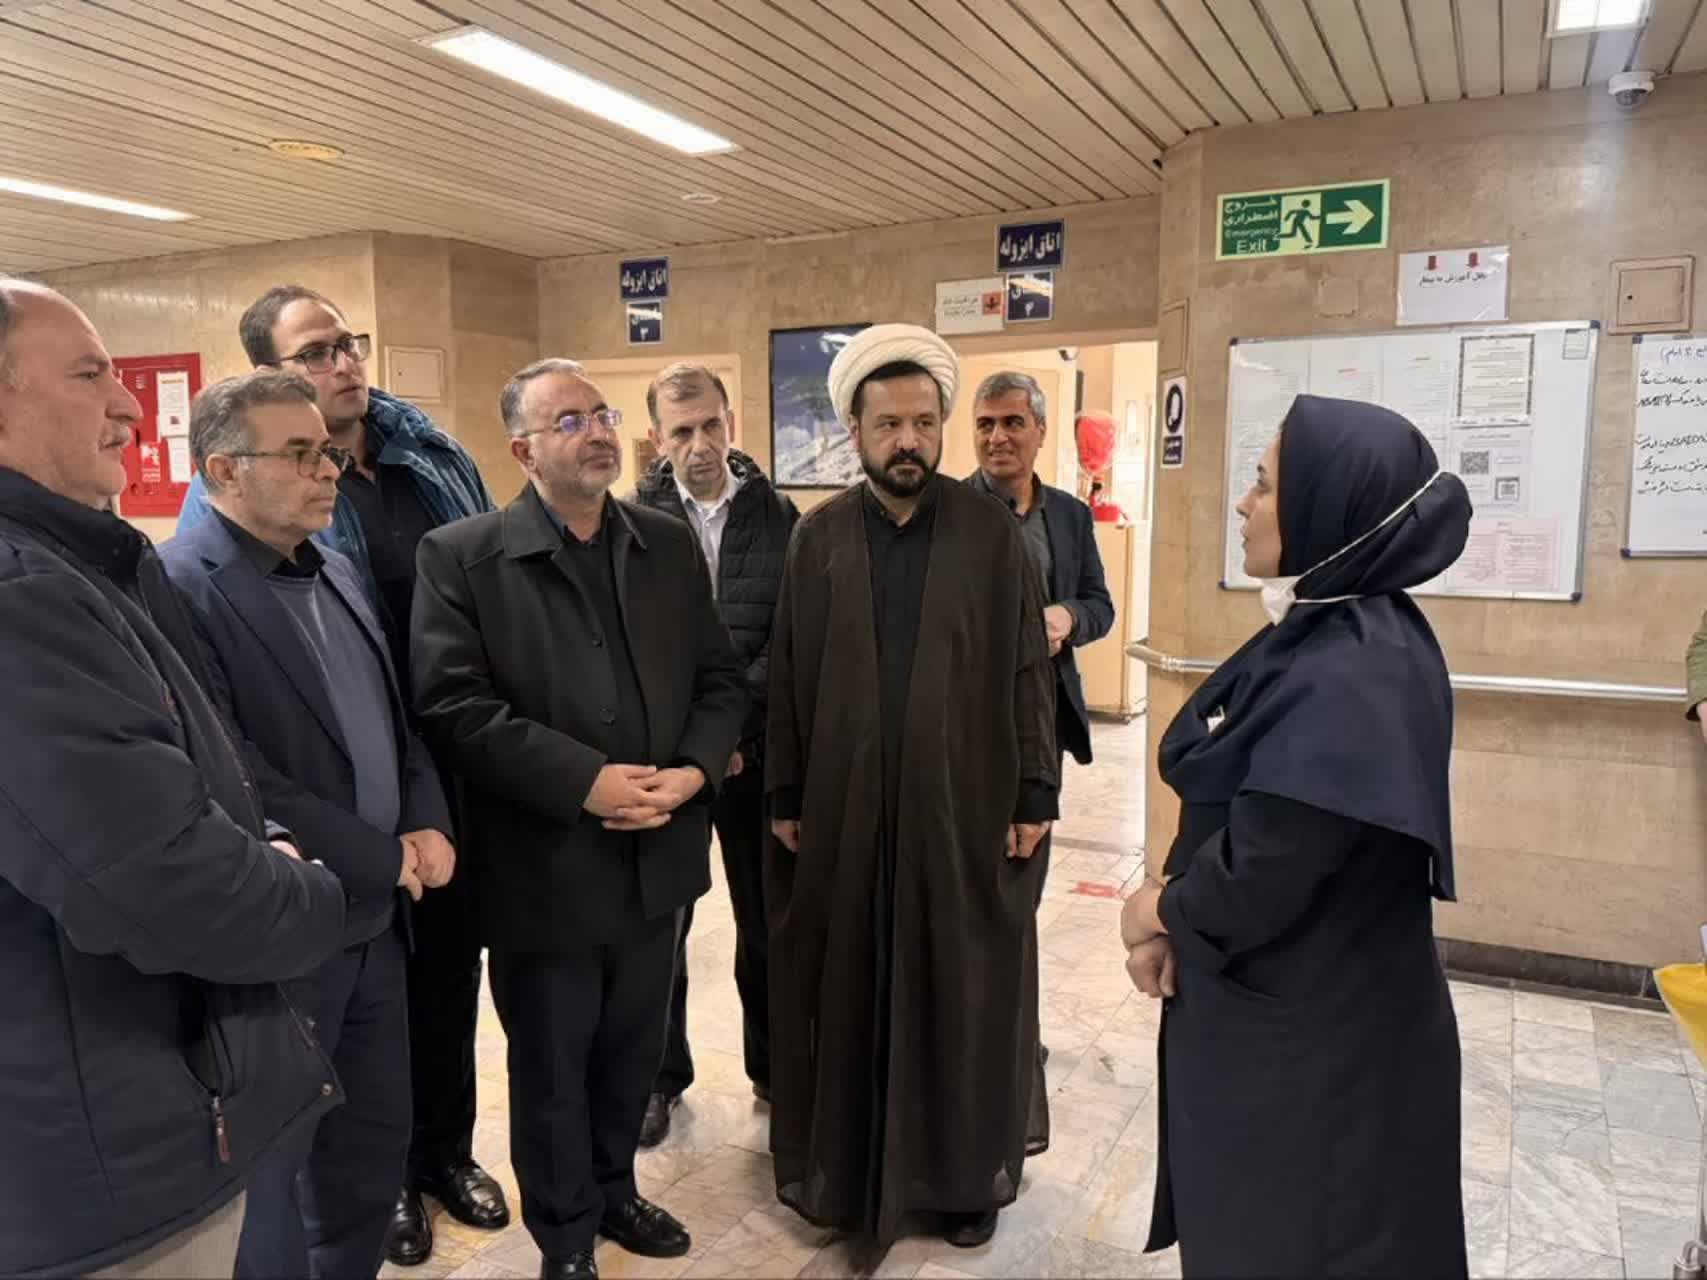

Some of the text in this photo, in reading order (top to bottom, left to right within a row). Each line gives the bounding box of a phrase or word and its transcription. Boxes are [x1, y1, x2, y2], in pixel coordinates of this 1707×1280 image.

[1225, 226, 1280, 240] Emergency
[1000, 232, 1060, 262] اتاق ایزوله
[1236, 239, 1267, 254] Exit
[622, 267, 667, 293] اتاق ایزوله
